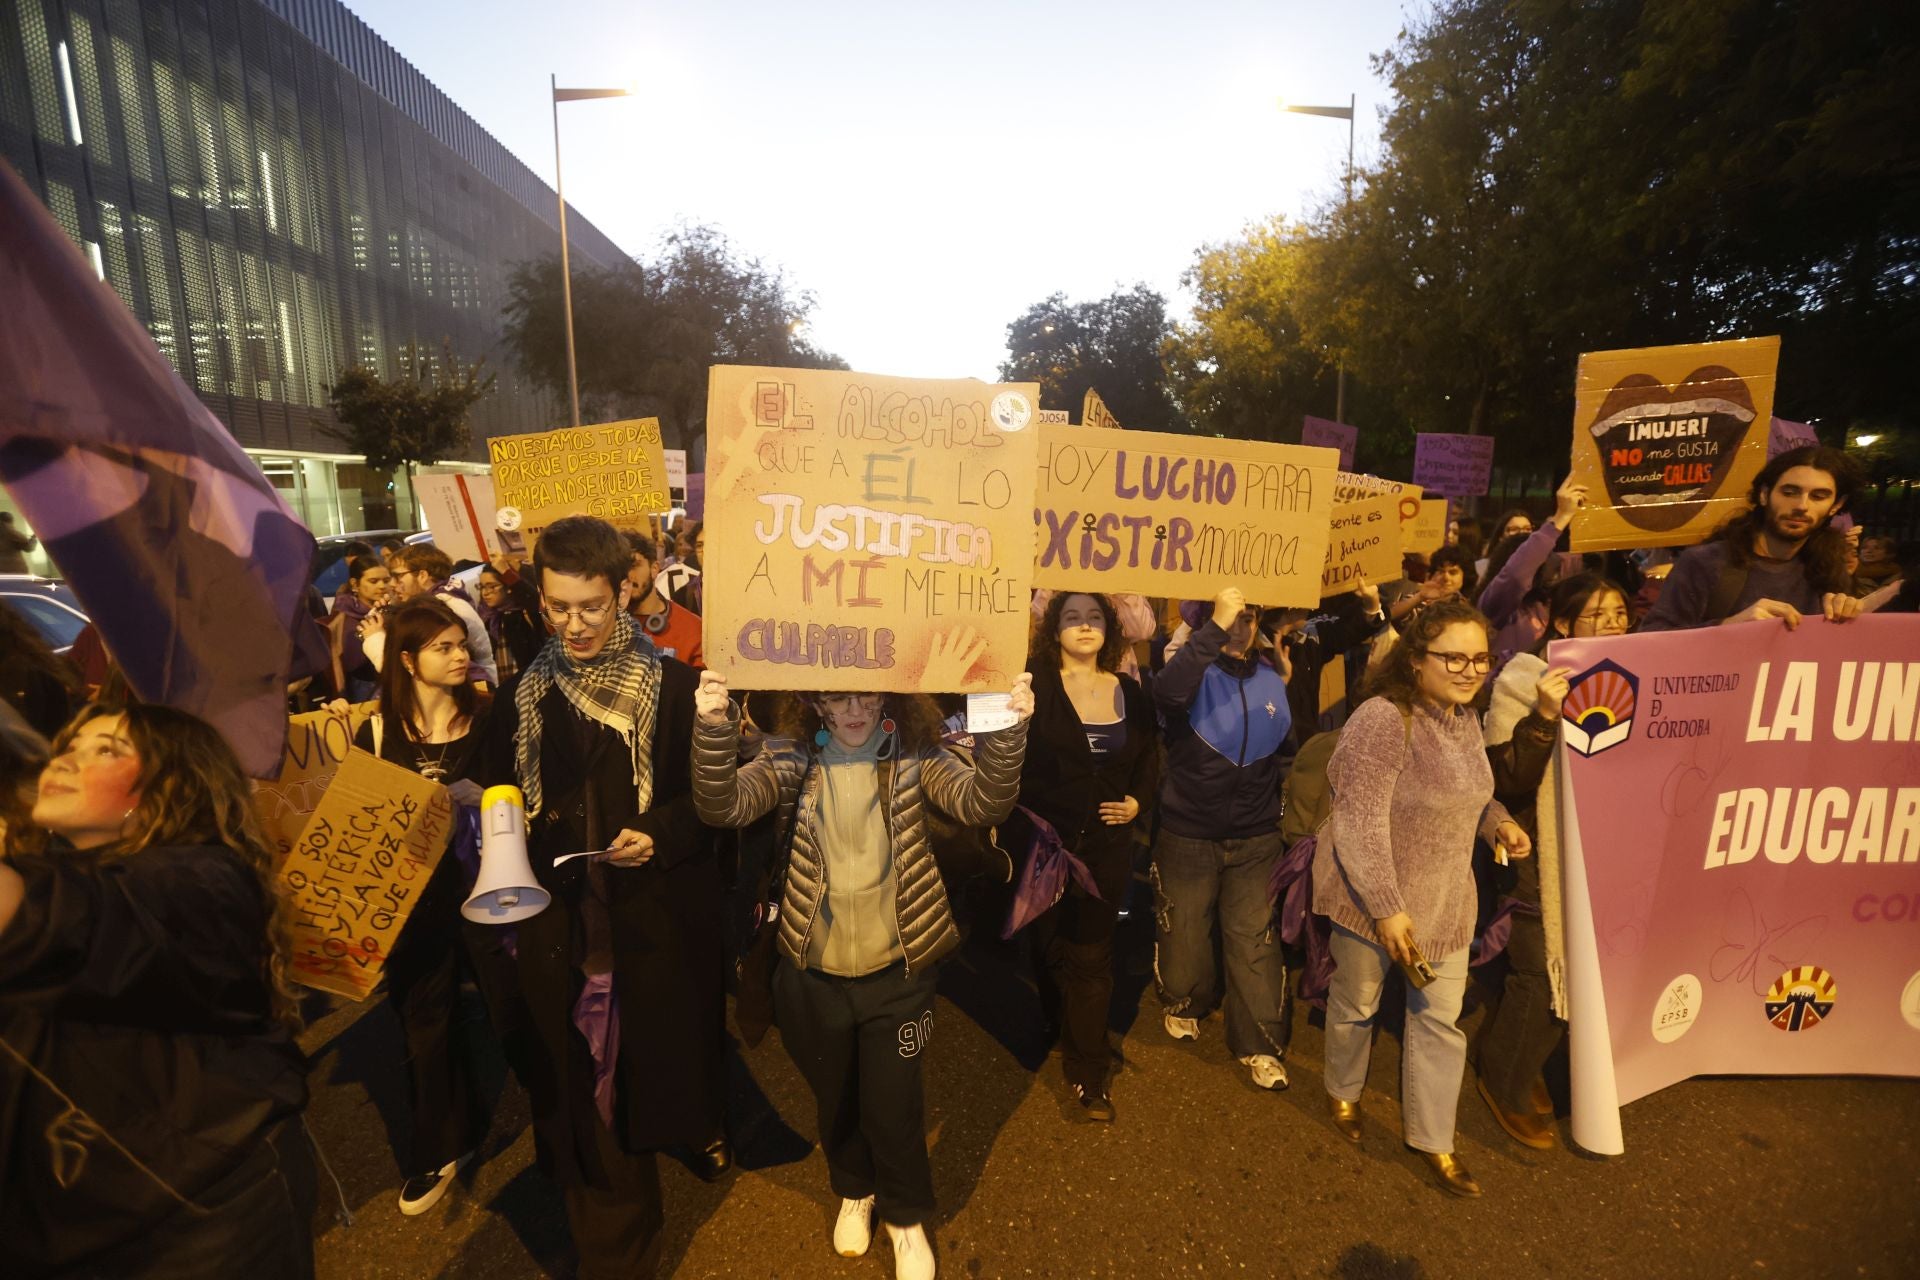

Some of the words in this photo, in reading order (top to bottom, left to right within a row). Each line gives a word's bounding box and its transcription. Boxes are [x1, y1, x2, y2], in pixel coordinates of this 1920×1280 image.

[755, 381, 814, 430] EL
[838, 384, 1004, 449] ALCOHOL
[1629, 417, 1709, 441] ¡MUJER!
[491, 440, 518, 464] NO
[521, 430, 594, 457] ESTAMOS
[600, 423, 659, 446] TODAS
[498, 456, 562, 487] PORQUE
[567, 449, 623, 473] DESDE
[627, 447, 648, 464] LA
[1611, 448, 1643, 466] NO
[1647, 449, 1673, 458] me
[1678, 441, 1718, 458] GUSTA
[504, 482, 551, 510] TUMBA
[600, 467, 652, 496] PUEDE
[758, 442, 815, 474] QUE
[830, 448, 849, 478] A
[958, 461, 1011, 509] LO
[1115, 450, 1236, 506] LUCHO
[1244, 463, 1312, 513] PARA
[1616, 471, 1665, 483] cuando
[1664, 463, 1713, 485] CALLAS
[755, 493, 993, 570] JUSTIFICA
[1368, 511, 1382, 522] es
[1193, 522, 1299, 579] mañana
[745, 552, 776, 596] A
[904, 568, 946, 618] ME
[737, 618, 895, 669] CULPABLE
[1654, 674, 1740, 695] UNIVERSIDAD
[1745, 661, 1818, 742] LA
[1832, 661, 1920, 742] UN
[1647, 716, 1710, 738] CÓRDOBA
[300, 817, 333, 862] SOY
[1703, 787, 1920, 870] EDUCAR
[344, 884, 379, 920] LA
[364, 831, 403, 880] VOZ
[390, 794, 418, 832] DE
[351, 935, 380, 968] LO
[370, 883, 410, 930] QUE
